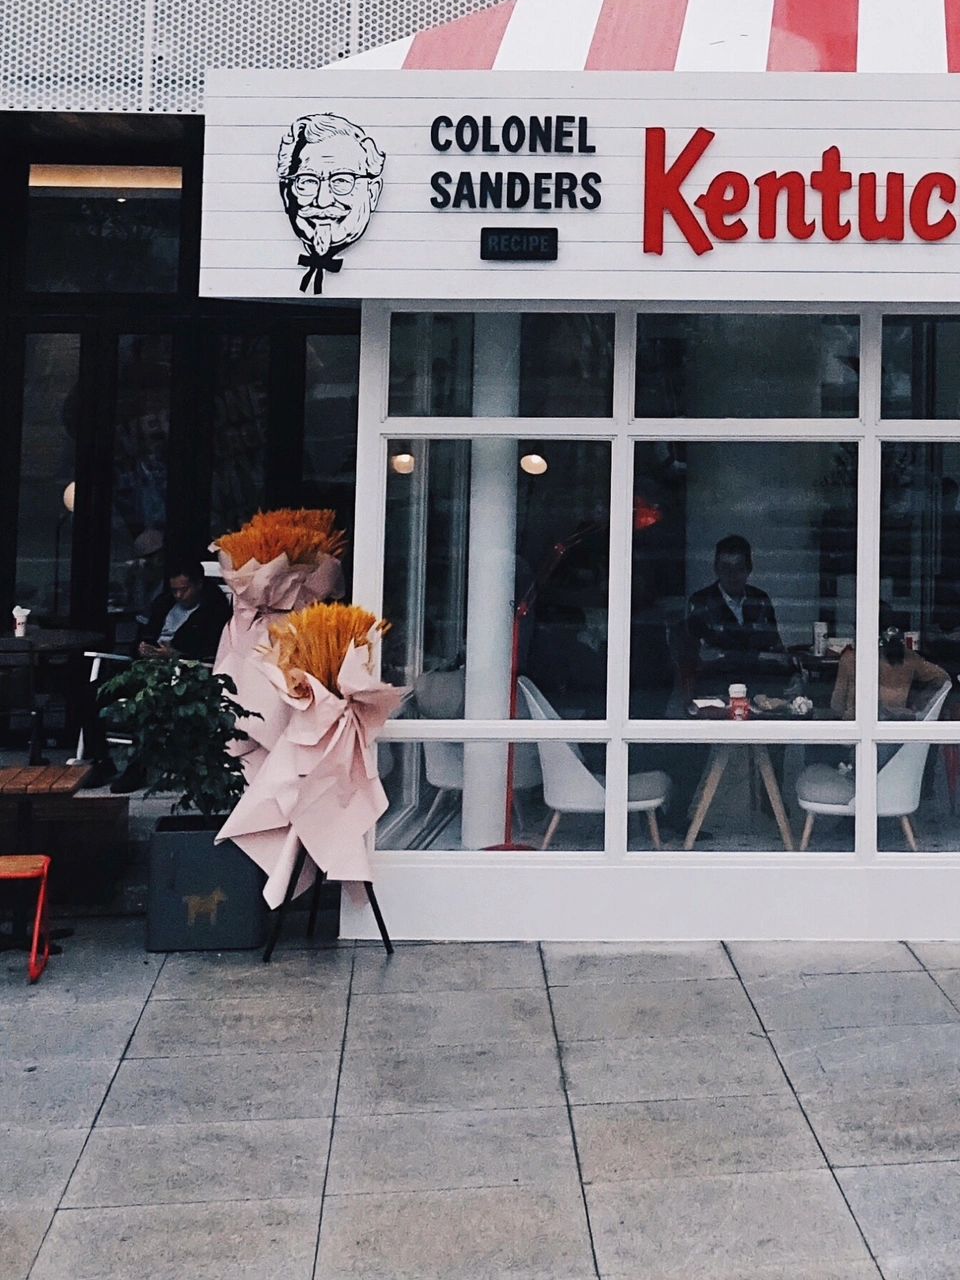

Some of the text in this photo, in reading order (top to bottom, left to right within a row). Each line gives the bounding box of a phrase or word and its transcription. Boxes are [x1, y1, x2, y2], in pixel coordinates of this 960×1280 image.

[430, 115, 596, 153] COLONEL
[430, 171, 601, 210] SANDERS
[488, 234, 549, 253] RECIPE
